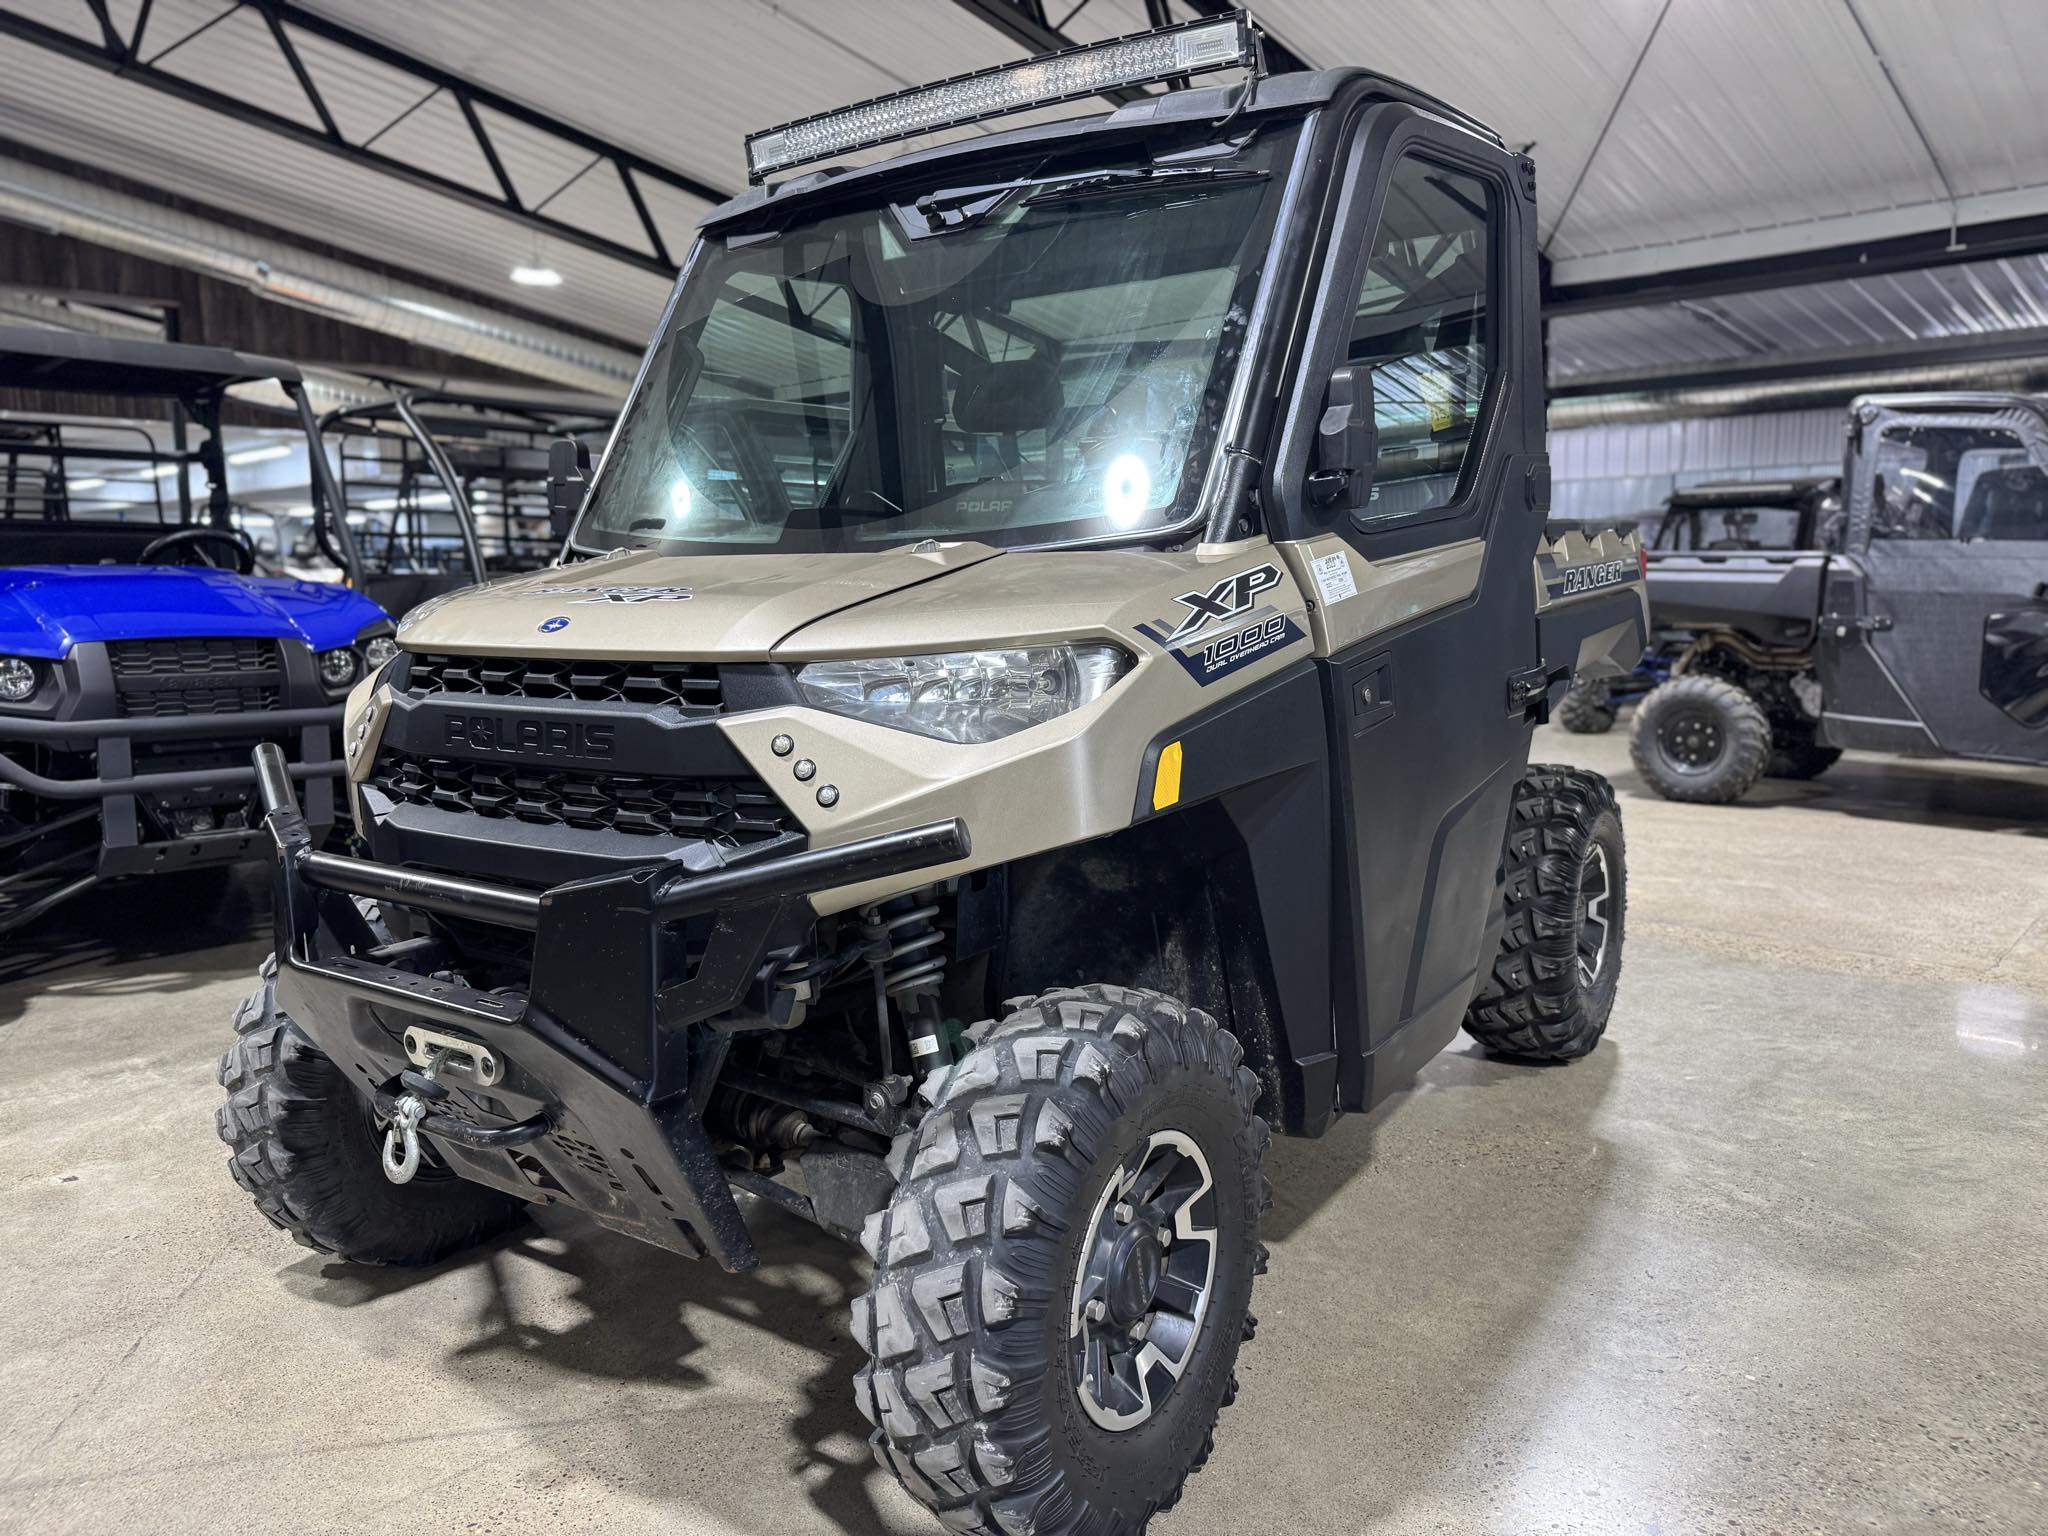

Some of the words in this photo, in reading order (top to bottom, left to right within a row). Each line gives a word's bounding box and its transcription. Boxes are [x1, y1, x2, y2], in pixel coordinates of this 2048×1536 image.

[955, 500, 1013, 513] POLAR
[1563, 560, 1623, 594] RANGER
[566, 594, 693, 604] XP
[1164, 561, 1284, 642] XP
[1203, 612, 1286, 666] 1000
[1206, 659, 1228, 673] DUAL
[1229, 641, 1269, 663] OVERHEAD
[1269, 632, 1286, 644] CAM
[444, 714, 616, 761] POLARIS
